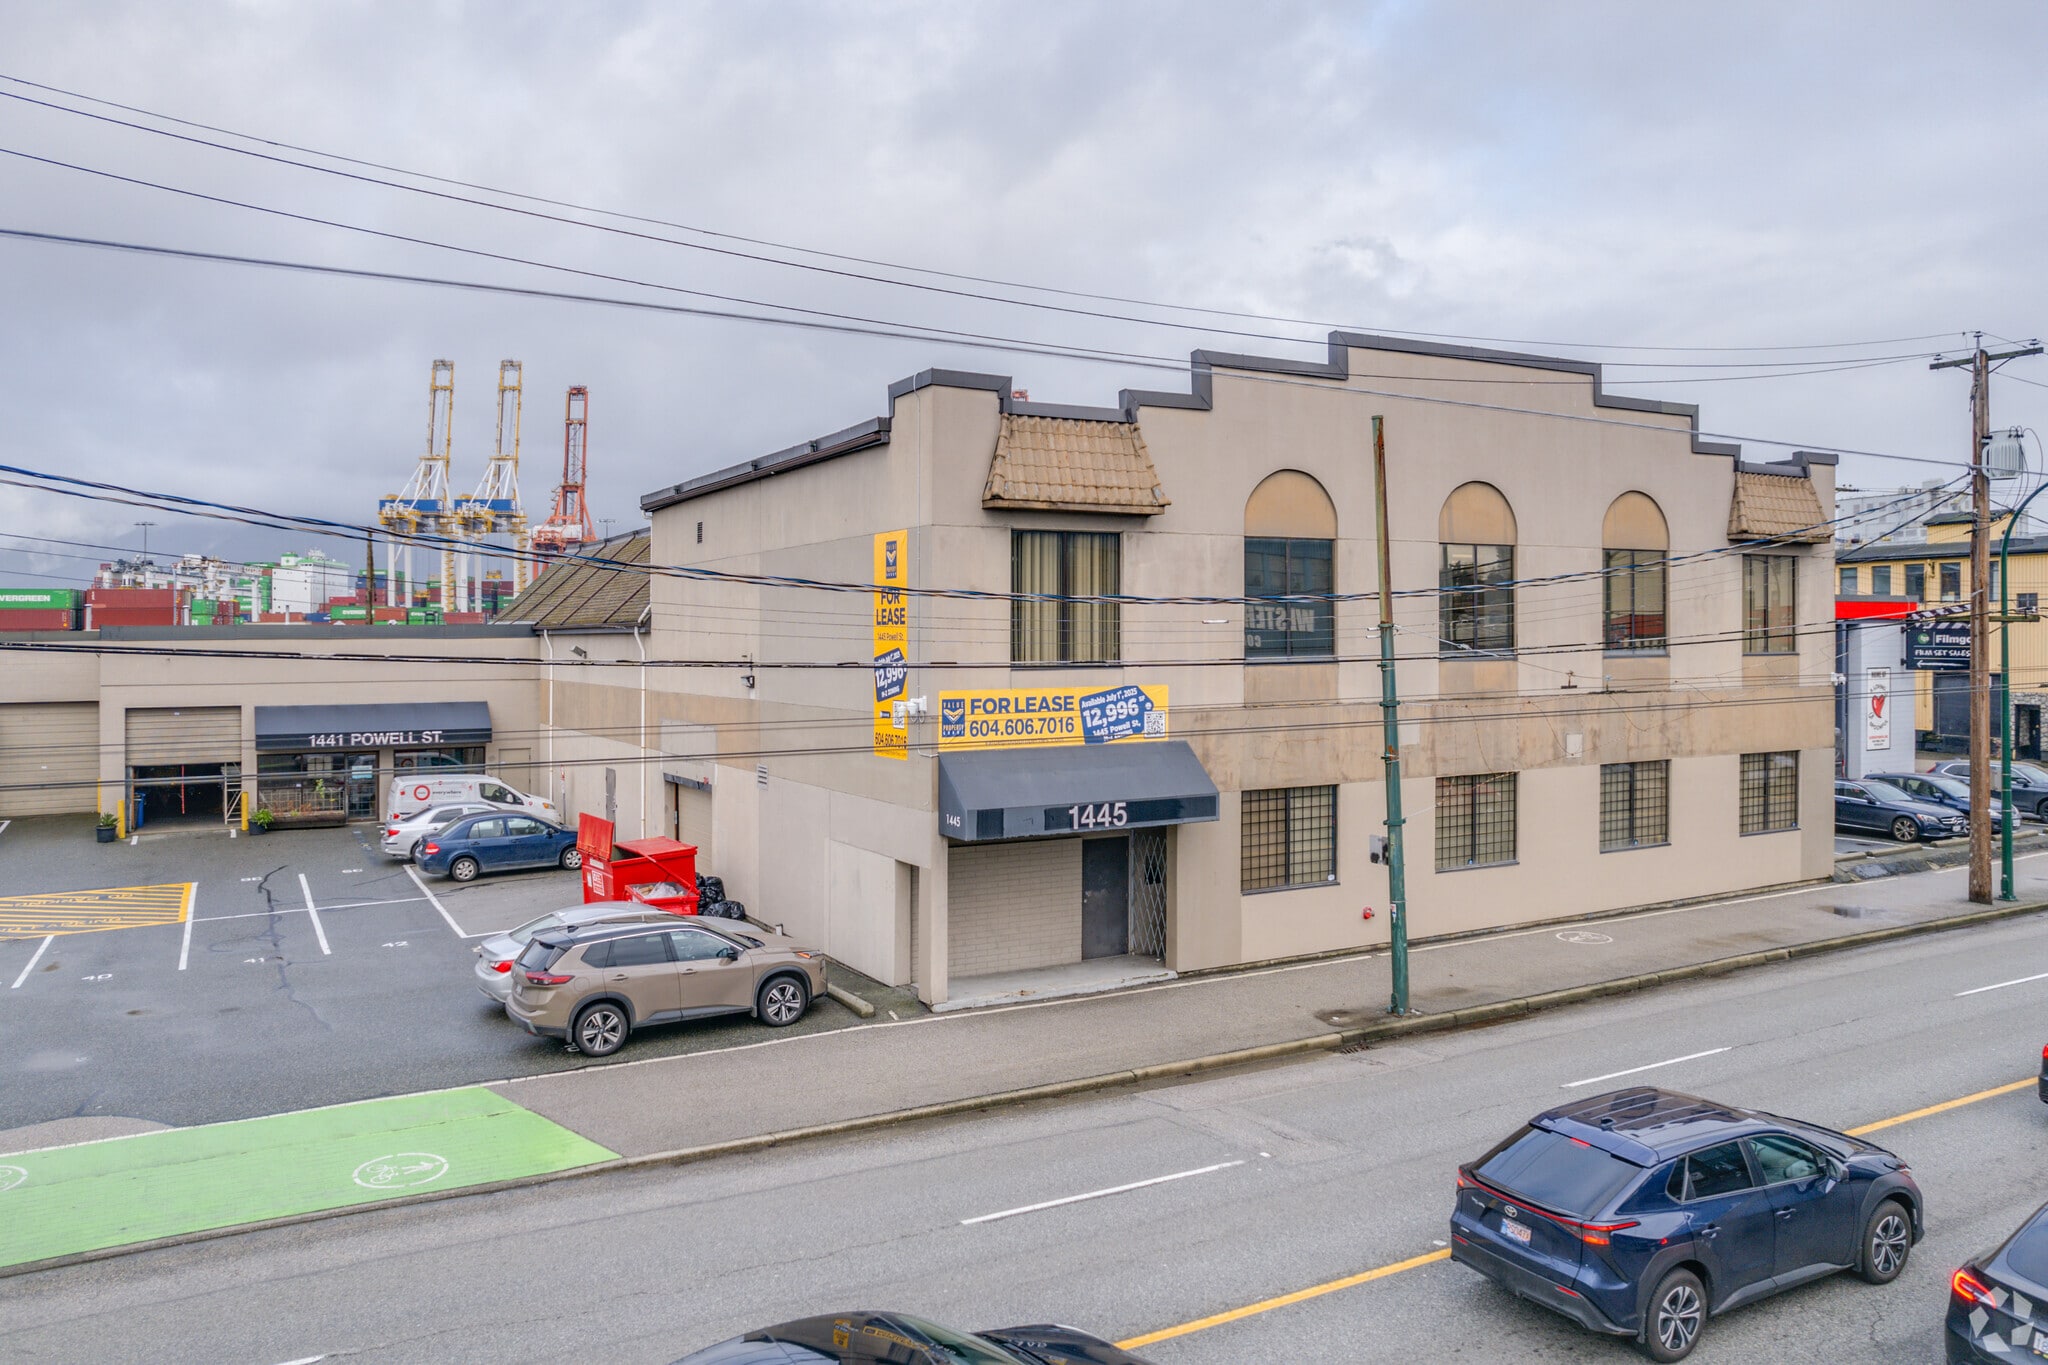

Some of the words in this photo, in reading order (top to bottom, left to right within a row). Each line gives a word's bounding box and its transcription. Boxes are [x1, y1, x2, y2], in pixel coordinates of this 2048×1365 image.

[881, 588, 900, 605] FOR
[876, 608, 906, 626] LEASE
[1949, 649, 1971, 657] SALES
[970, 697, 1011, 715] FOR
[1014, 695, 1075, 713] LEASE
[1081, 695, 1106, 709] Available
[1106, 692, 1117, 702] July
[1124, 687, 1138, 698] 2025
[1083, 697, 1140, 728] 12,996
[969, 716, 1075, 738] 604.606.7016
[1092, 727, 1109, 737] 1445
[1109, 721, 1131, 733] Powell
[308, 734, 344, 748] 1441
[351, 731, 418, 746] POWELL
[421, 730, 445, 744] ST.
[945, 813, 961, 828] 1445
[1069, 802, 1128, 830] 1445
[81, 973, 113, 982] 40
